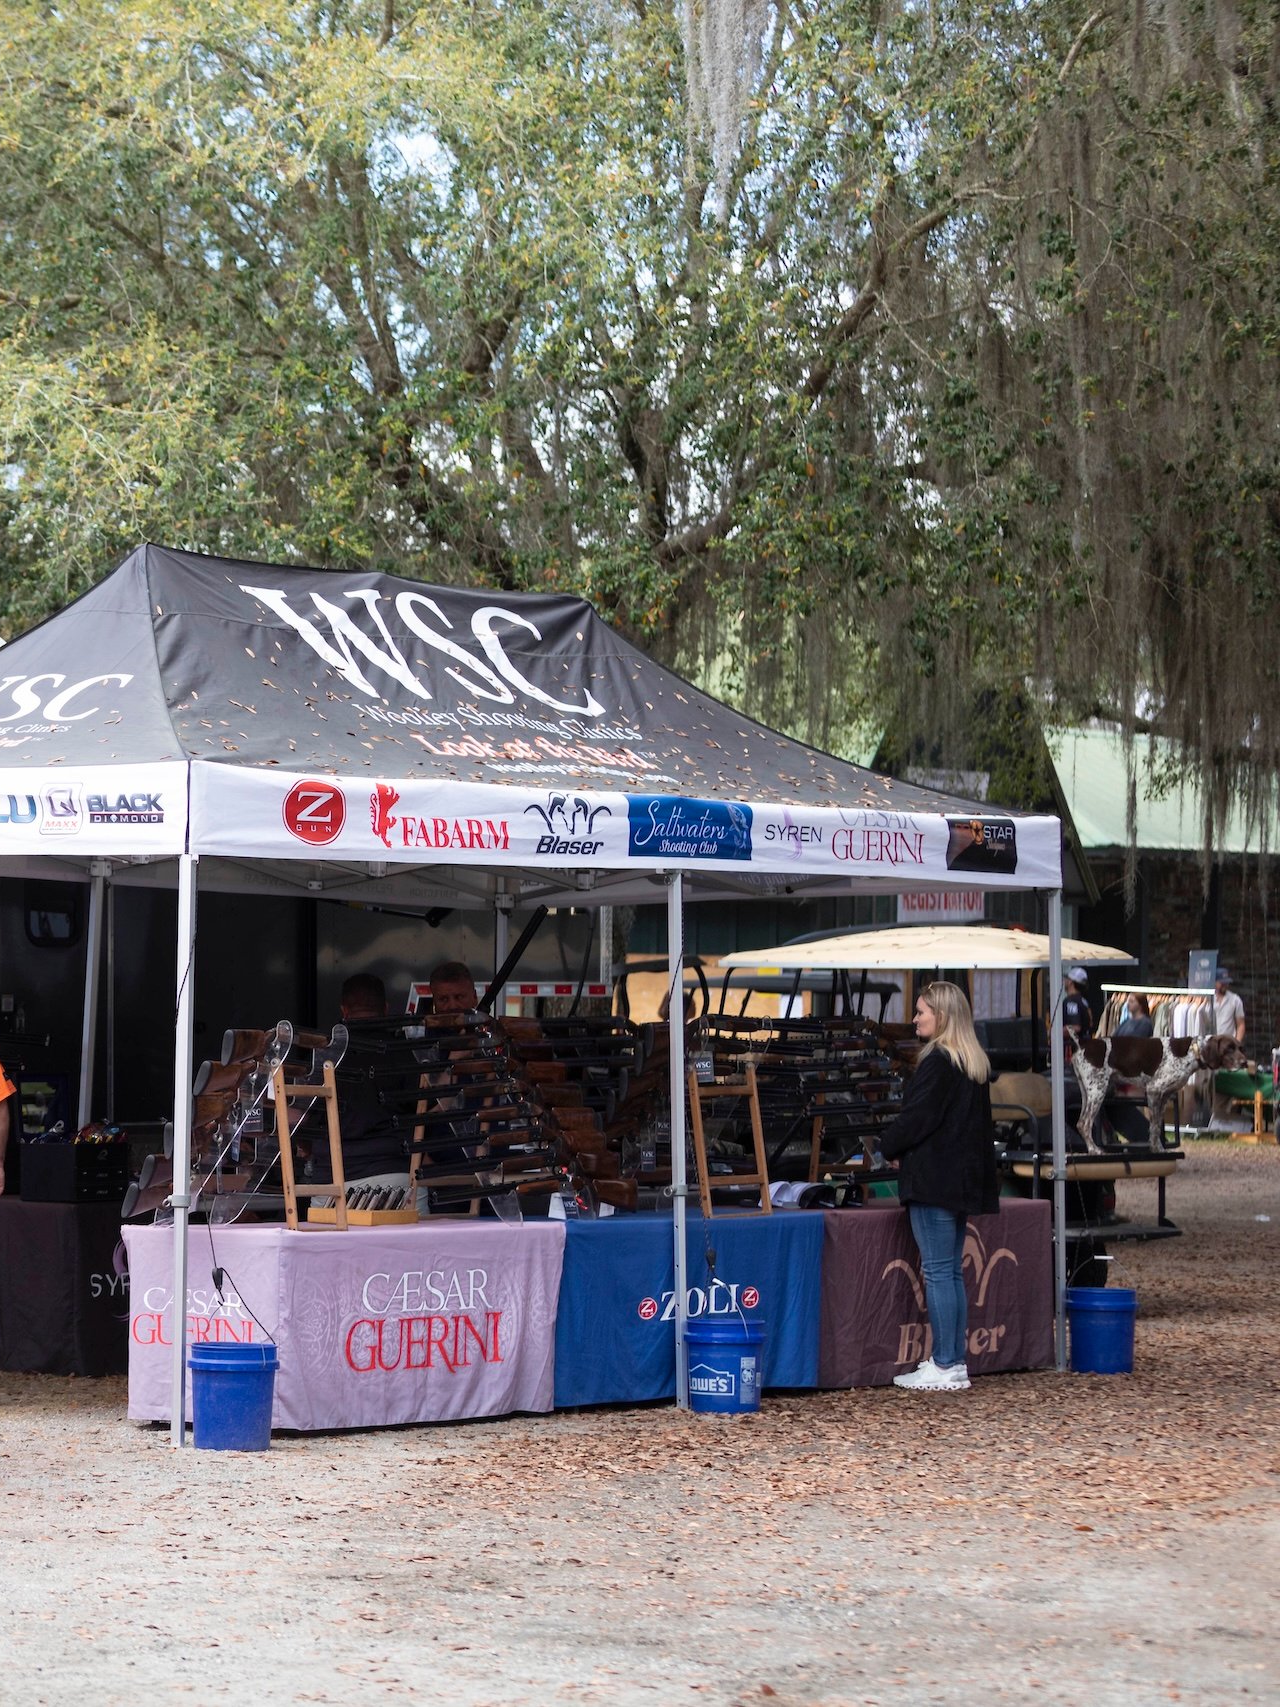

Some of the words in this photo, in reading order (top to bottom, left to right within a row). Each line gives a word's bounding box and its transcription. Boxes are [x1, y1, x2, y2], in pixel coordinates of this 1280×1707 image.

[238, 585, 606, 718] WSC
[14, 724, 72, 734] Clinics
[352, 703, 465, 730] Woolley
[456, 706, 573, 739] Shooting
[564, 719, 642, 740] Clinics
[409, 734, 498, 758] Look
[86, 793, 164, 812] BLACK
[297, 792, 334, 823] Z
[296, 825, 332, 833] GUN
[399, 816, 510, 850] FABARM
[634, 800, 728, 846] Saltwaters
[764, 824, 822, 842] SYREN
[984, 826, 1014, 840] STAR
[536, 835, 604, 855] Blaser
[659, 840, 697, 856] Shooting
[699, 841, 718, 854] Club
[832, 828, 926, 866] GUERINI
[363, 1269, 493, 1314] CÆSAR
[346, 1312, 504, 1374] GUERINI
